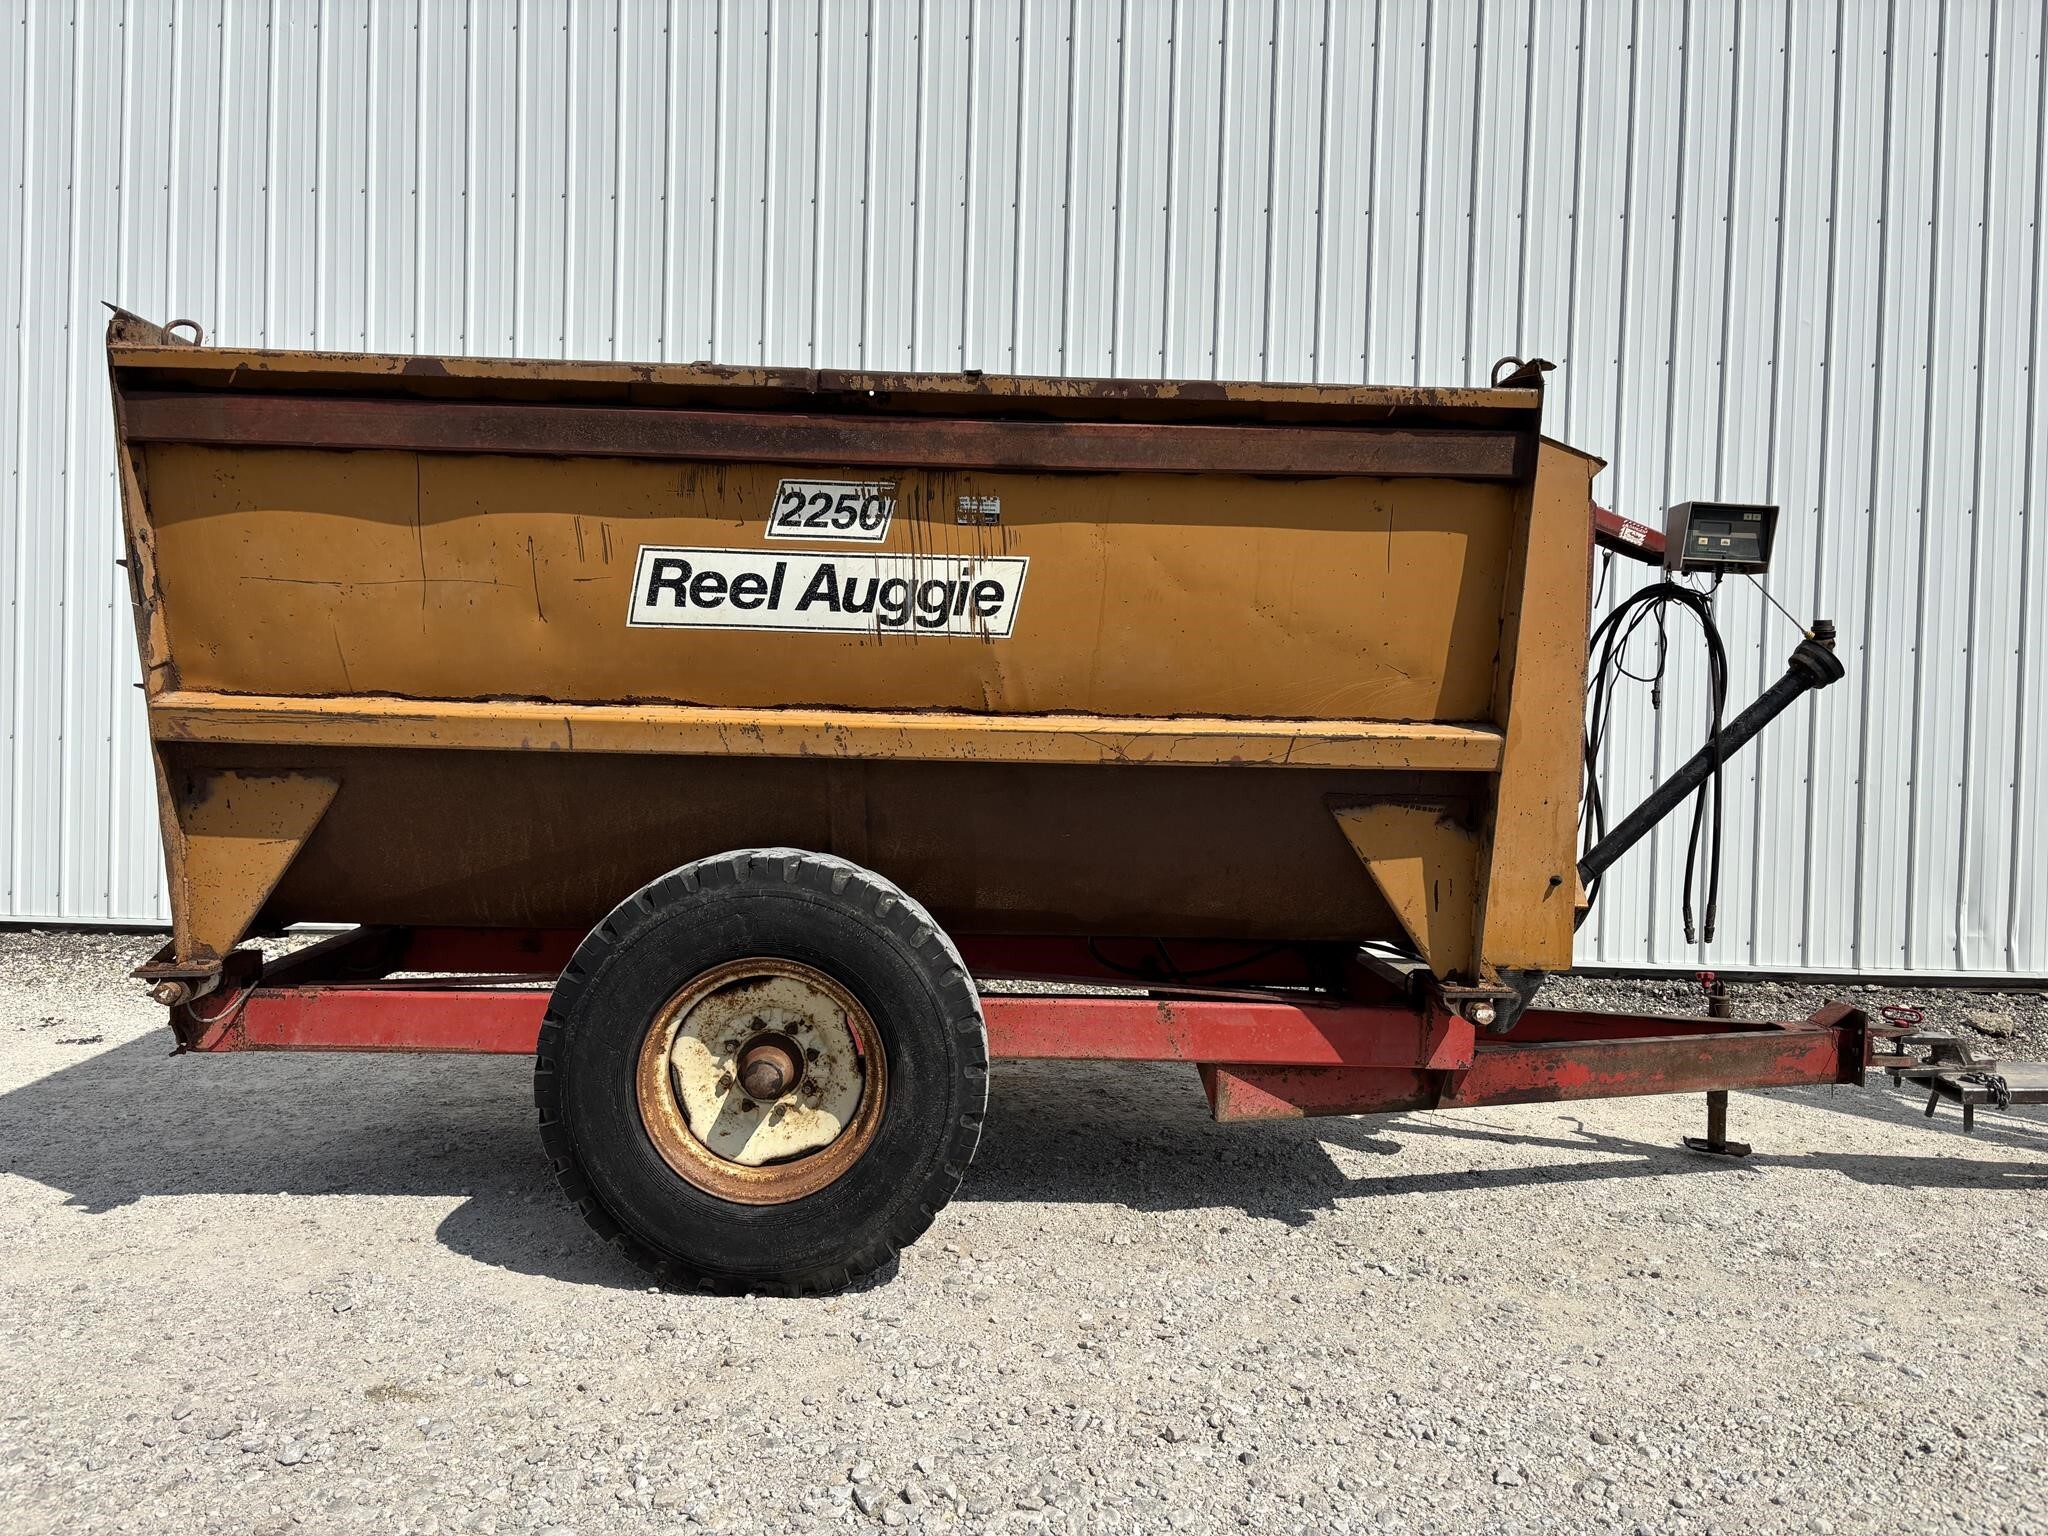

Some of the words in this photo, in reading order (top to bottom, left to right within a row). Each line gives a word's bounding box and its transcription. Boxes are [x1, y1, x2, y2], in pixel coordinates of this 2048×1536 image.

[777, 491, 885, 531] 2250
[645, 558, 787, 610] Reel
[795, 563, 1005, 628] Auggie
